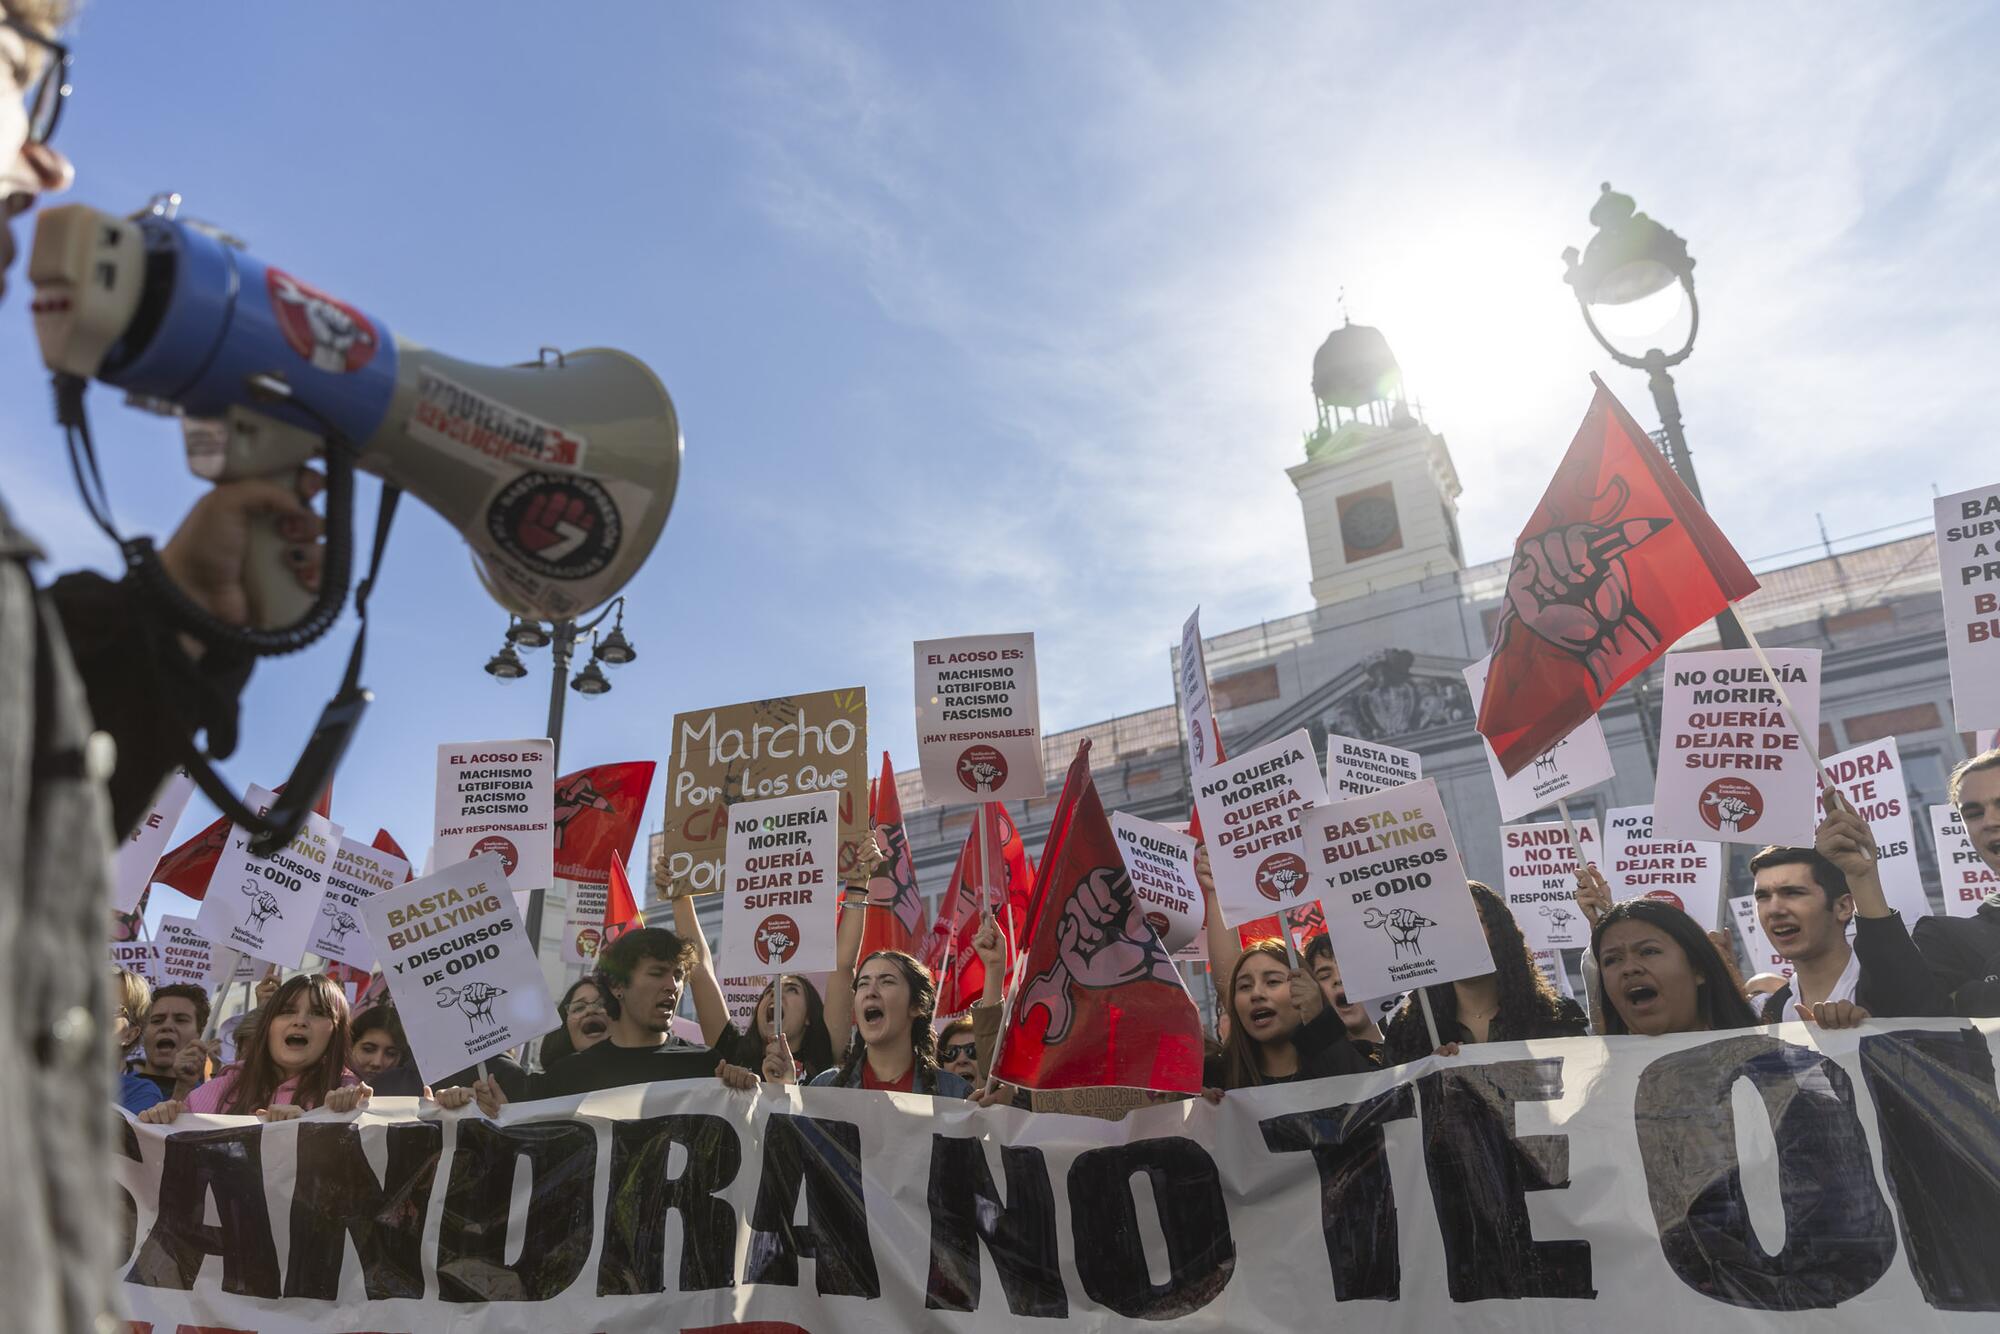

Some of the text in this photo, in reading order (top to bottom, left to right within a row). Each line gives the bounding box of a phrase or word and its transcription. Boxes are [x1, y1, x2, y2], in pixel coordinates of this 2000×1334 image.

[1974, 543, 1990, 558] A
[927, 649, 1024, 665] EL ACOSO ES:
[938, 667, 1014, 681] MACHISMO
[1675, 671, 1706, 686] NO
[937, 680, 1016, 694] LGTBIFOBIA
[945, 693, 1009, 707] RACISMO
[1694, 689, 1782, 706] MORIR,
[942, 706, 1013, 721] FASCISMO
[1688, 708, 1785, 729] QUERÍA
[679, 709, 856, 768] Marcho
[923, 728, 1035, 745] ¡HAY RESPONSABLES!
[1676, 733, 1798, 749] DEJAR DE
[450, 752, 543, 765] EL ACOSO ES:
[1343, 744, 1409, 768] BASTA DE
[1685, 754, 1783, 770] SUFRIR
[460, 768, 532, 780] MACHISMO
[1201, 749, 1305, 798] NO QUERÍA
[1336, 755, 1417, 780] SUBVENCIONES
[1346, 769, 1353, 778] A
[458, 781, 533, 792] LGTBIFOBIA
[675, 765, 848, 807] Por Los Que
[1221, 773, 1293, 807] MORIR,
[1850, 780, 1877, 803] TE
[465, 792, 526, 803] RACISMO
[1223, 788, 1301, 826] QUERÍA
[461, 804, 529, 816] FASCISMO
[440, 823, 548, 837] ¡HAY RESPONSABLES!
[735, 819, 758, 834] NO
[762, 807, 828, 831] QUERÍA
[1323, 808, 1424, 842] BASTA DE
[1612, 818, 1637, 828] NO
[1218, 814, 1283, 847] DEJAR
[313, 834, 327, 847] DE
[749, 831, 812, 850] MORIR,
[1118, 827, 1188, 862] NO QUERÍA
[1322, 822, 1436, 865] BULLYING
[1624, 840, 1696, 856] QUERÍA
[247, 844, 321, 883] CURSOS
[337, 848, 394, 878] BASTA DE
[745, 848, 814, 873] QUERÍA
[1130, 846, 1179, 872] MORIR,
[1525, 848, 1576, 861] NO TE
[1616, 857, 1707, 871] DEJAR DE
[245, 863, 301, 892] DE ODIO
[1134, 859, 1186, 885] QUERÍA
[1326, 848, 1447, 888] Y DISCURSOS
[327, 876, 376, 897] DISCURS
[736, 870, 823, 892] DEJAR DE
[1131, 869, 1196, 901] DEJAR DE
[1352, 872, 1432, 904] DE ODIO
[1543, 880, 1564, 889] HAY
[1625, 873, 1696, 885] SUFRIR
[326, 891, 339, 900] DE
[744, 890, 812, 910] SUFRIR
[1137, 886, 1189, 915] SUFRIR
[387, 883, 489, 928] BASTA DE
[163, 925, 179, 933] NO
[387, 895, 502, 951] BULLYING
[170, 936, 211, 949] MORIR,
[393, 918, 514, 975] Y DISCURSOS
[127, 962, 146, 973] TE
[165, 957, 212, 971] EJAR DE
[422, 944, 500, 987] DE ODIO
[1388, 958, 1436, 975] Sindicato de
[1391, 968, 1438, 982] Estudiantes
[727, 994, 759, 1003] DISCURS
[739, 1007, 755, 1017] ODI
[464, 1025, 509, 1048] Sindicato de
[467, 1032, 512, 1056] Estudiantes
[118, 1110, 882, 1299] ANDRA
[926, 1132, 1237, 1319] NO
[1258, 1055, 1598, 1304] TE
